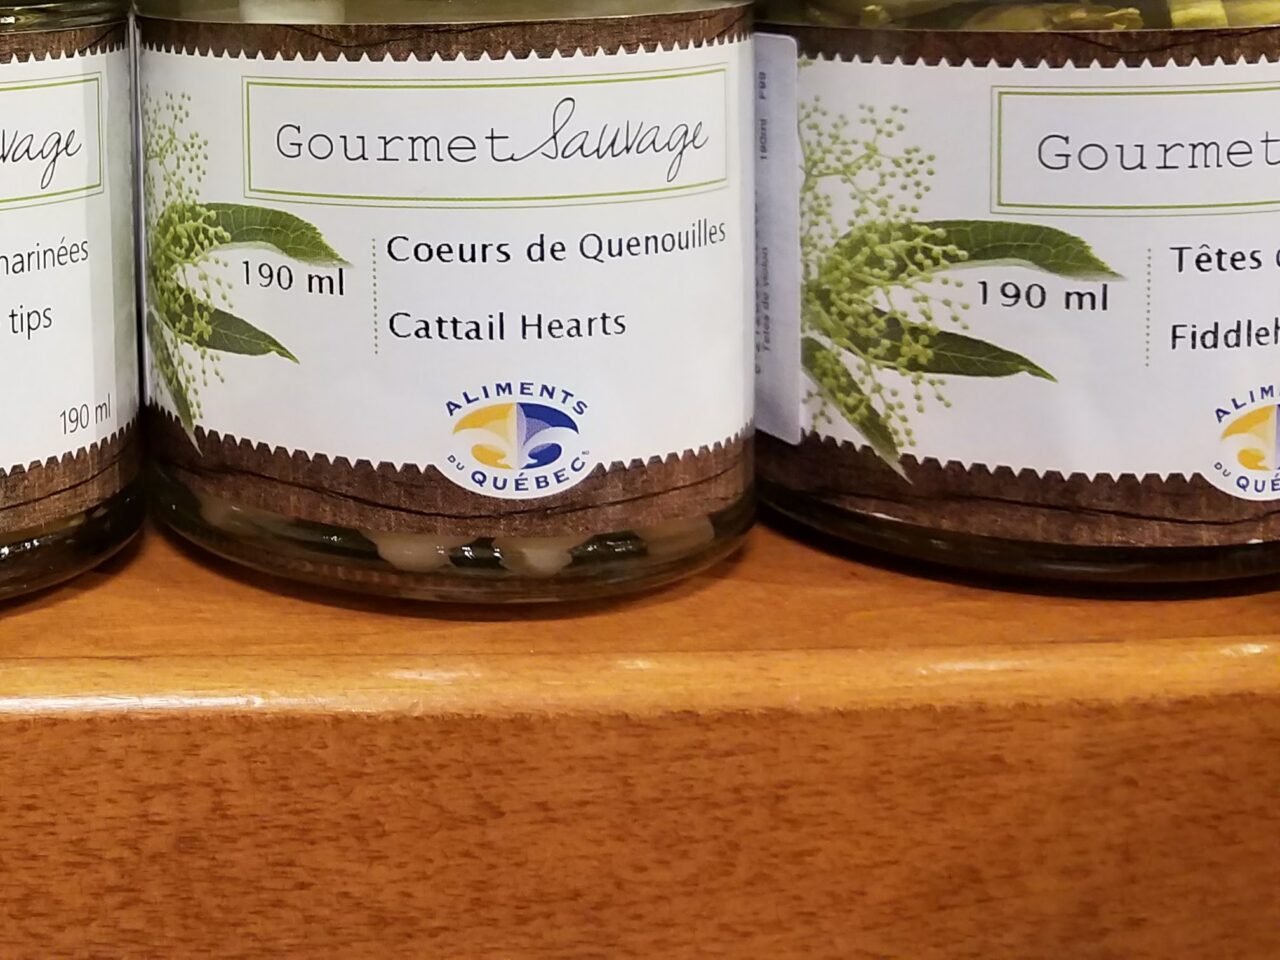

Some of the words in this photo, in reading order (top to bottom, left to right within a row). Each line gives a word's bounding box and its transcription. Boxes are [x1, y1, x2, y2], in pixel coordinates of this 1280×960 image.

[275, 123, 520, 163] Gourmet
[513, 96, 710, 183] Sauvage
[1038, 131, 1280, 171] Gourmet
[386, 233, 512, 265] Coeurs
[525, 232, 568, 264] de
[578, 217, 727, 266] Quenouilles
[1170, 243, 1263, 274] Têtes
[240, 259, 294, 292] 190
[306, 267, 346, 297] ml
[977, 280, 1047, 309] 190
[1064, 283, 1108, 312] ml
[8, 303, 54, 342] tips
[388, 311, 506, 343] Cattail
[520, 310, 628, 342] Hearts
[59, 403, 91, 436] 190
[94, 392, 113, 426] ml
[445, 381, 588, 417] ALIMENTS
[1215, 385, 1280, 423] ALIM
[471, 456, 587, 492] QUÉBEC
